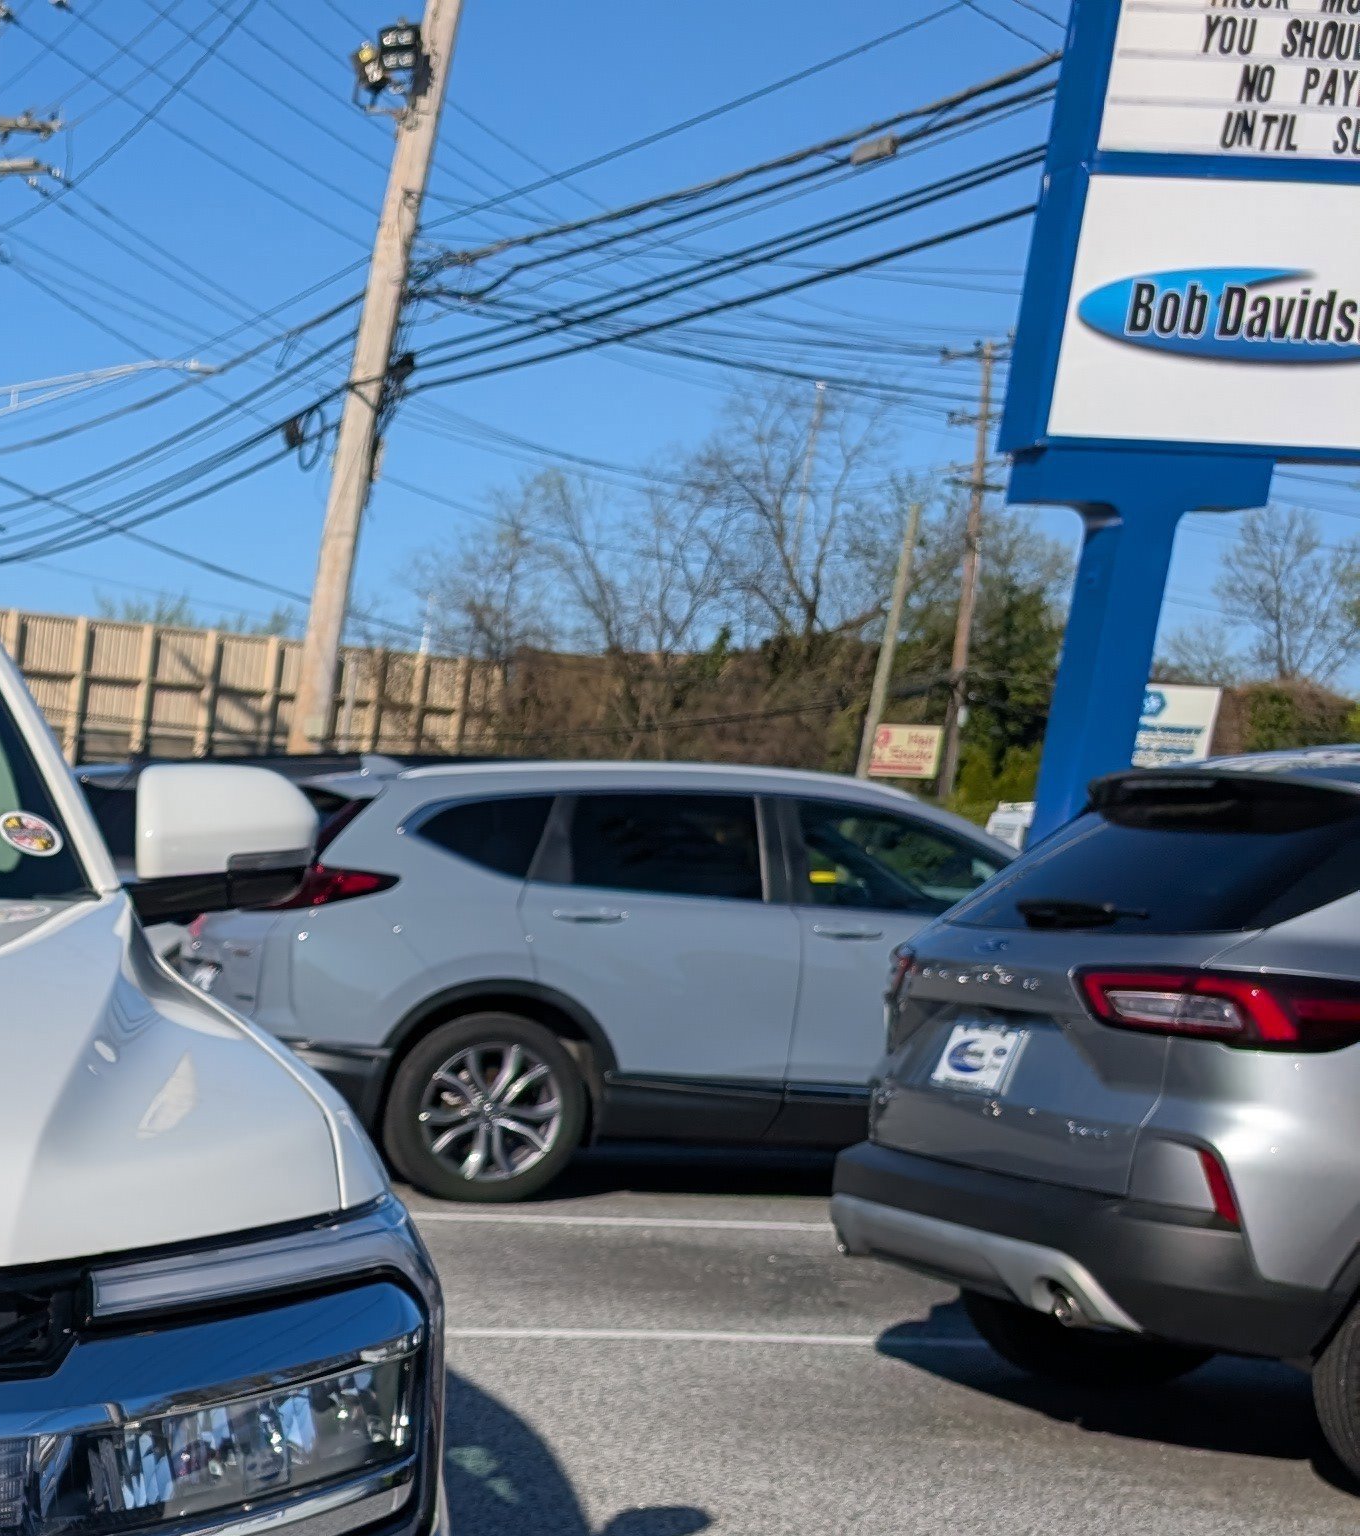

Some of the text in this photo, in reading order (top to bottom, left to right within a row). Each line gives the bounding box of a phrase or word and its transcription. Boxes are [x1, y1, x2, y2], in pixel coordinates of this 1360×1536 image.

[1202, 14, 1257, 55] YOU
[1237, 64, 1360, 107] NO PAY
[1220, 110, 1298, 151] UNTIL
[1128, 282, 1360, 342] Bob Davids
